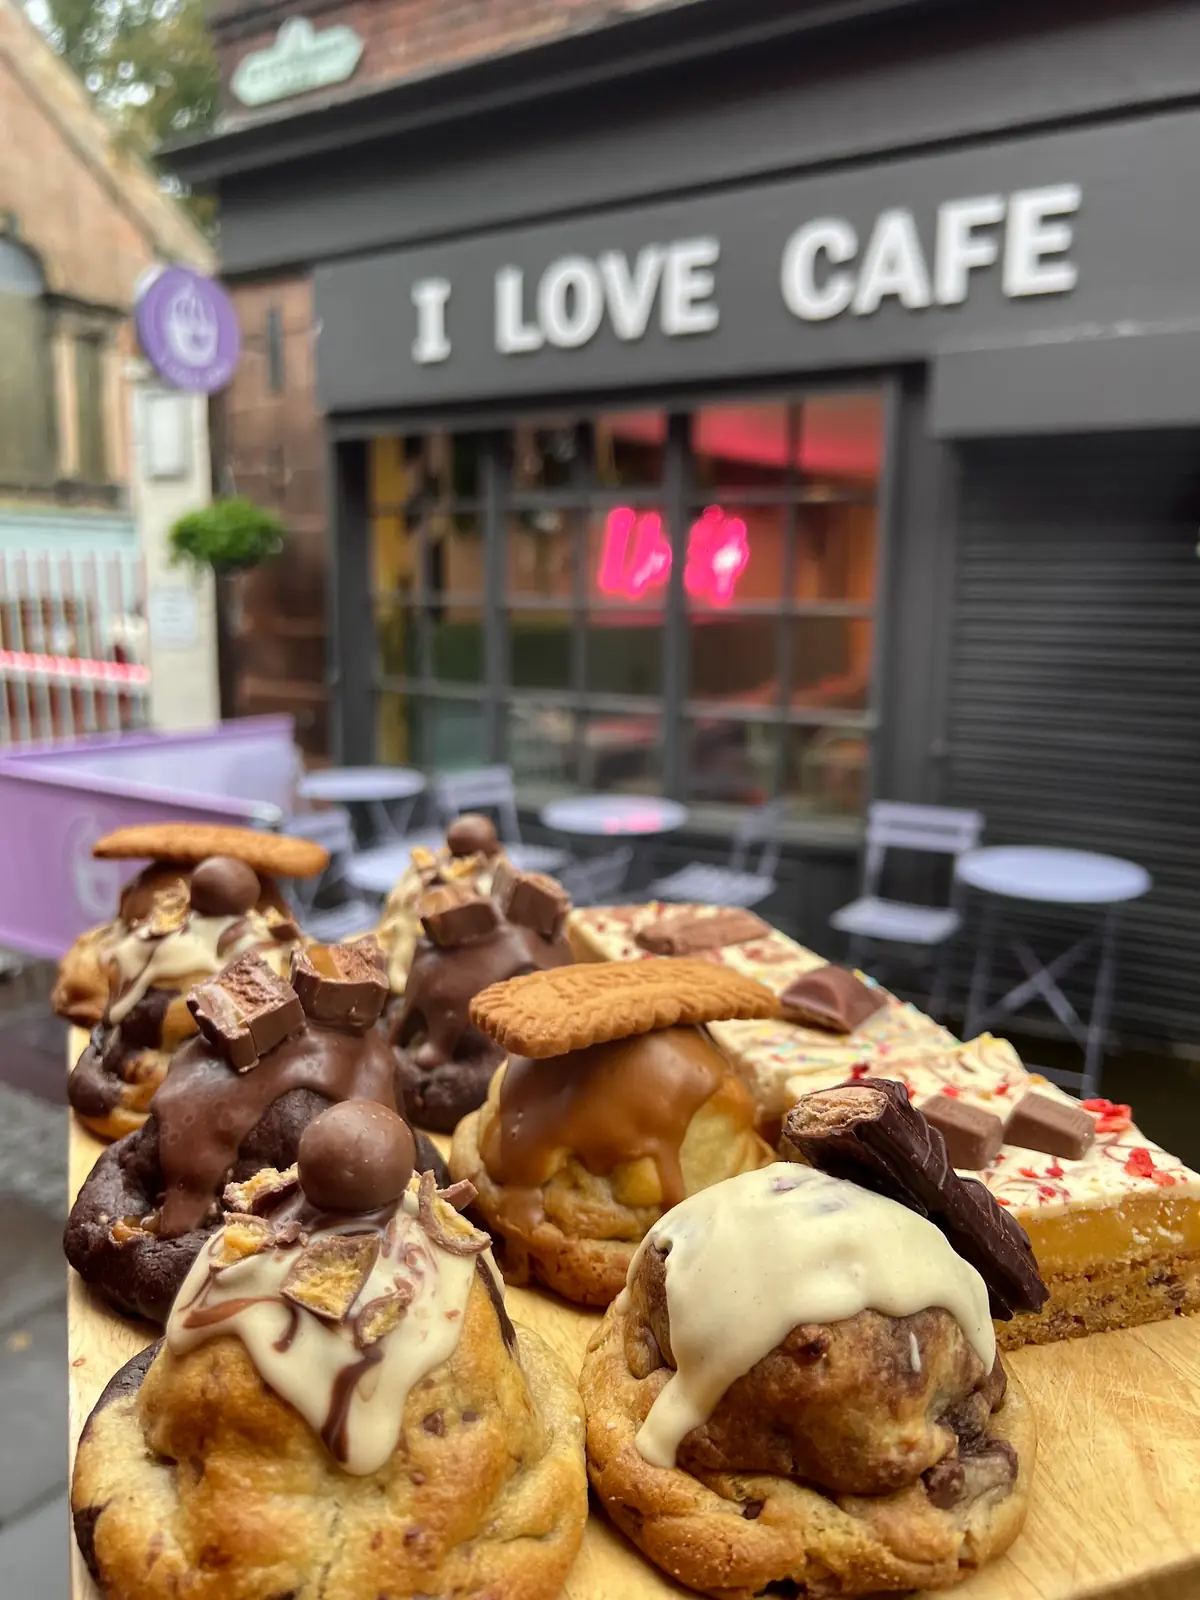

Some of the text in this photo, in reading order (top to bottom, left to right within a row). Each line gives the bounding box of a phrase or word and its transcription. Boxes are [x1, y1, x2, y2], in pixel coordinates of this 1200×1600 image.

[411, 183, 1081, 363] I LOVE CAFE
